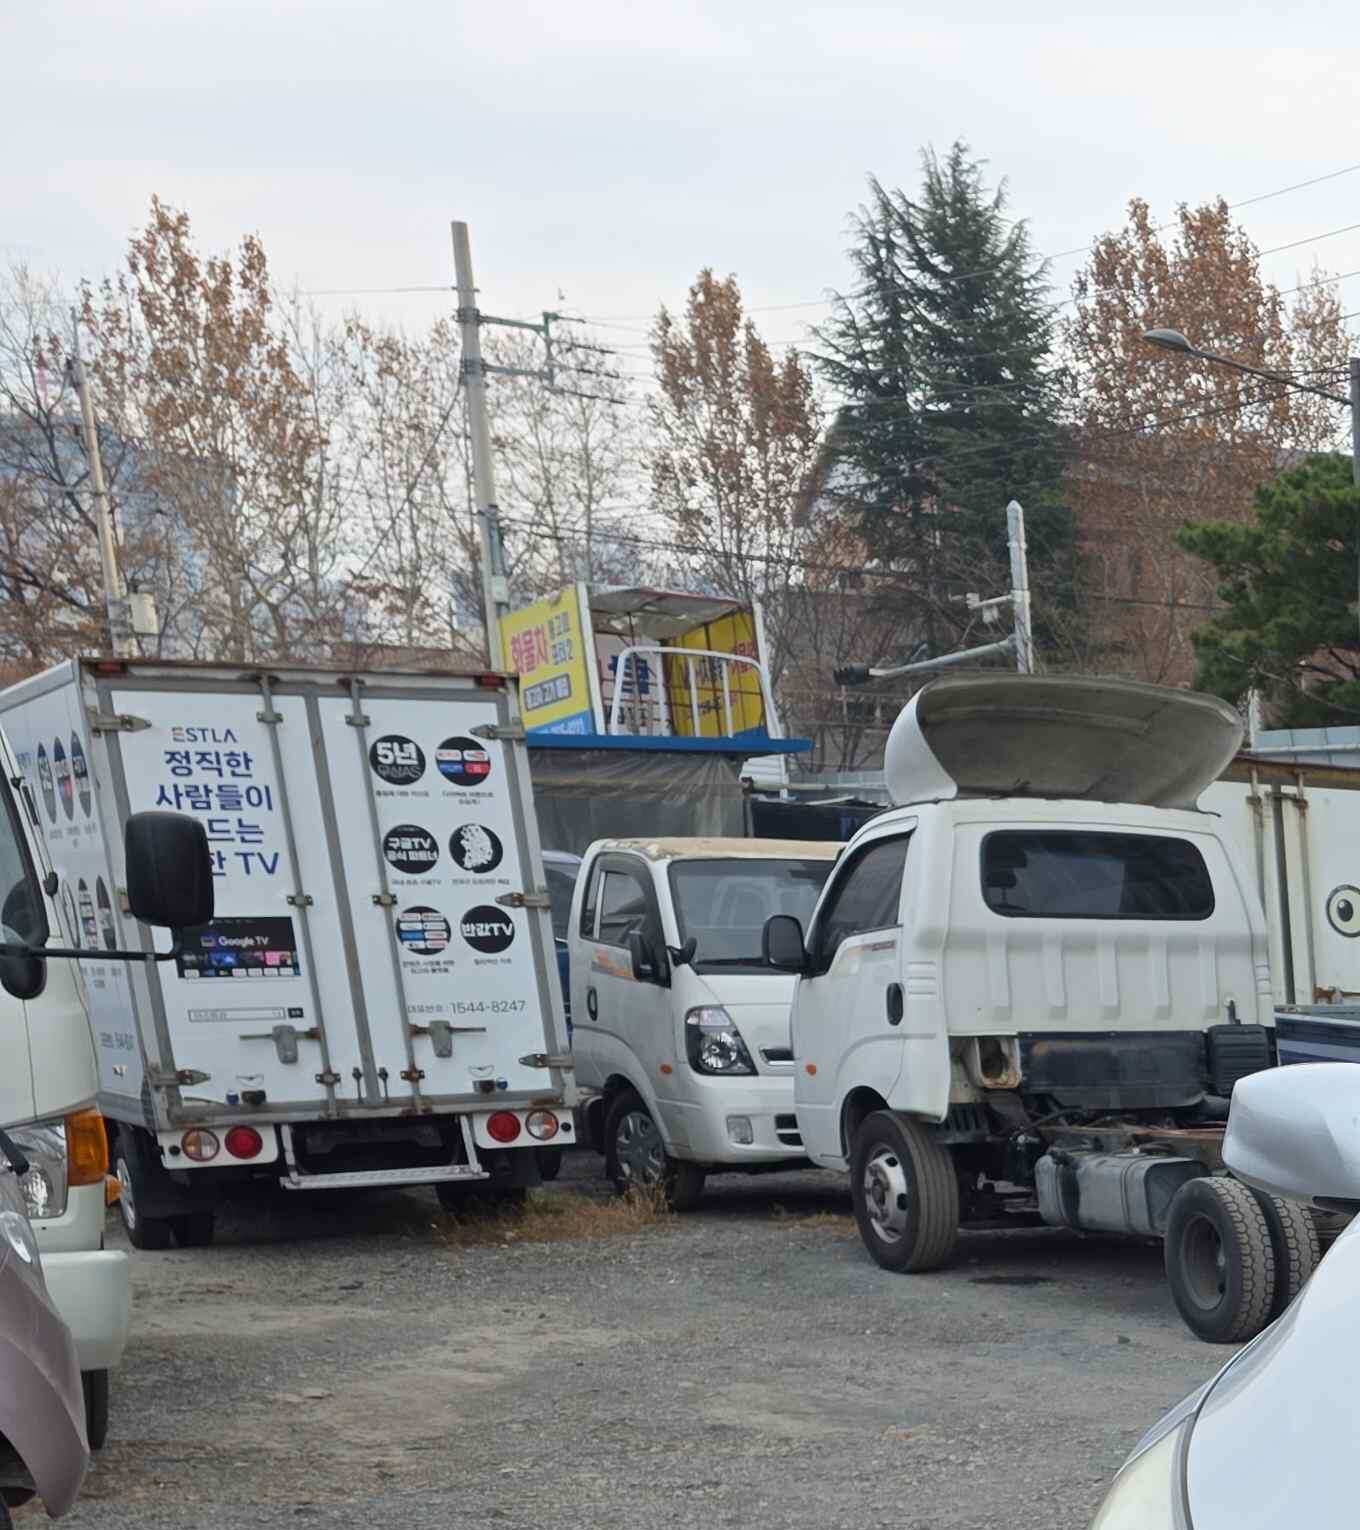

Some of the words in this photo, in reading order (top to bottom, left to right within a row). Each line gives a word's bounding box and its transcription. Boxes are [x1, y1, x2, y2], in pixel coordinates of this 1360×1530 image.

[171, 727, 238, 743] ESTLA
[164, 750, 253, 778] 정직한
[155, 784, 273, 811] 사람들이
[207, 818, 264, 844] 드는
[234, 852, 279, 875] TV
[218, 935, 254, 948] Google
[255, 936, 270, 946] TV
[449, 1000, 526, 1014] 1544-8247
